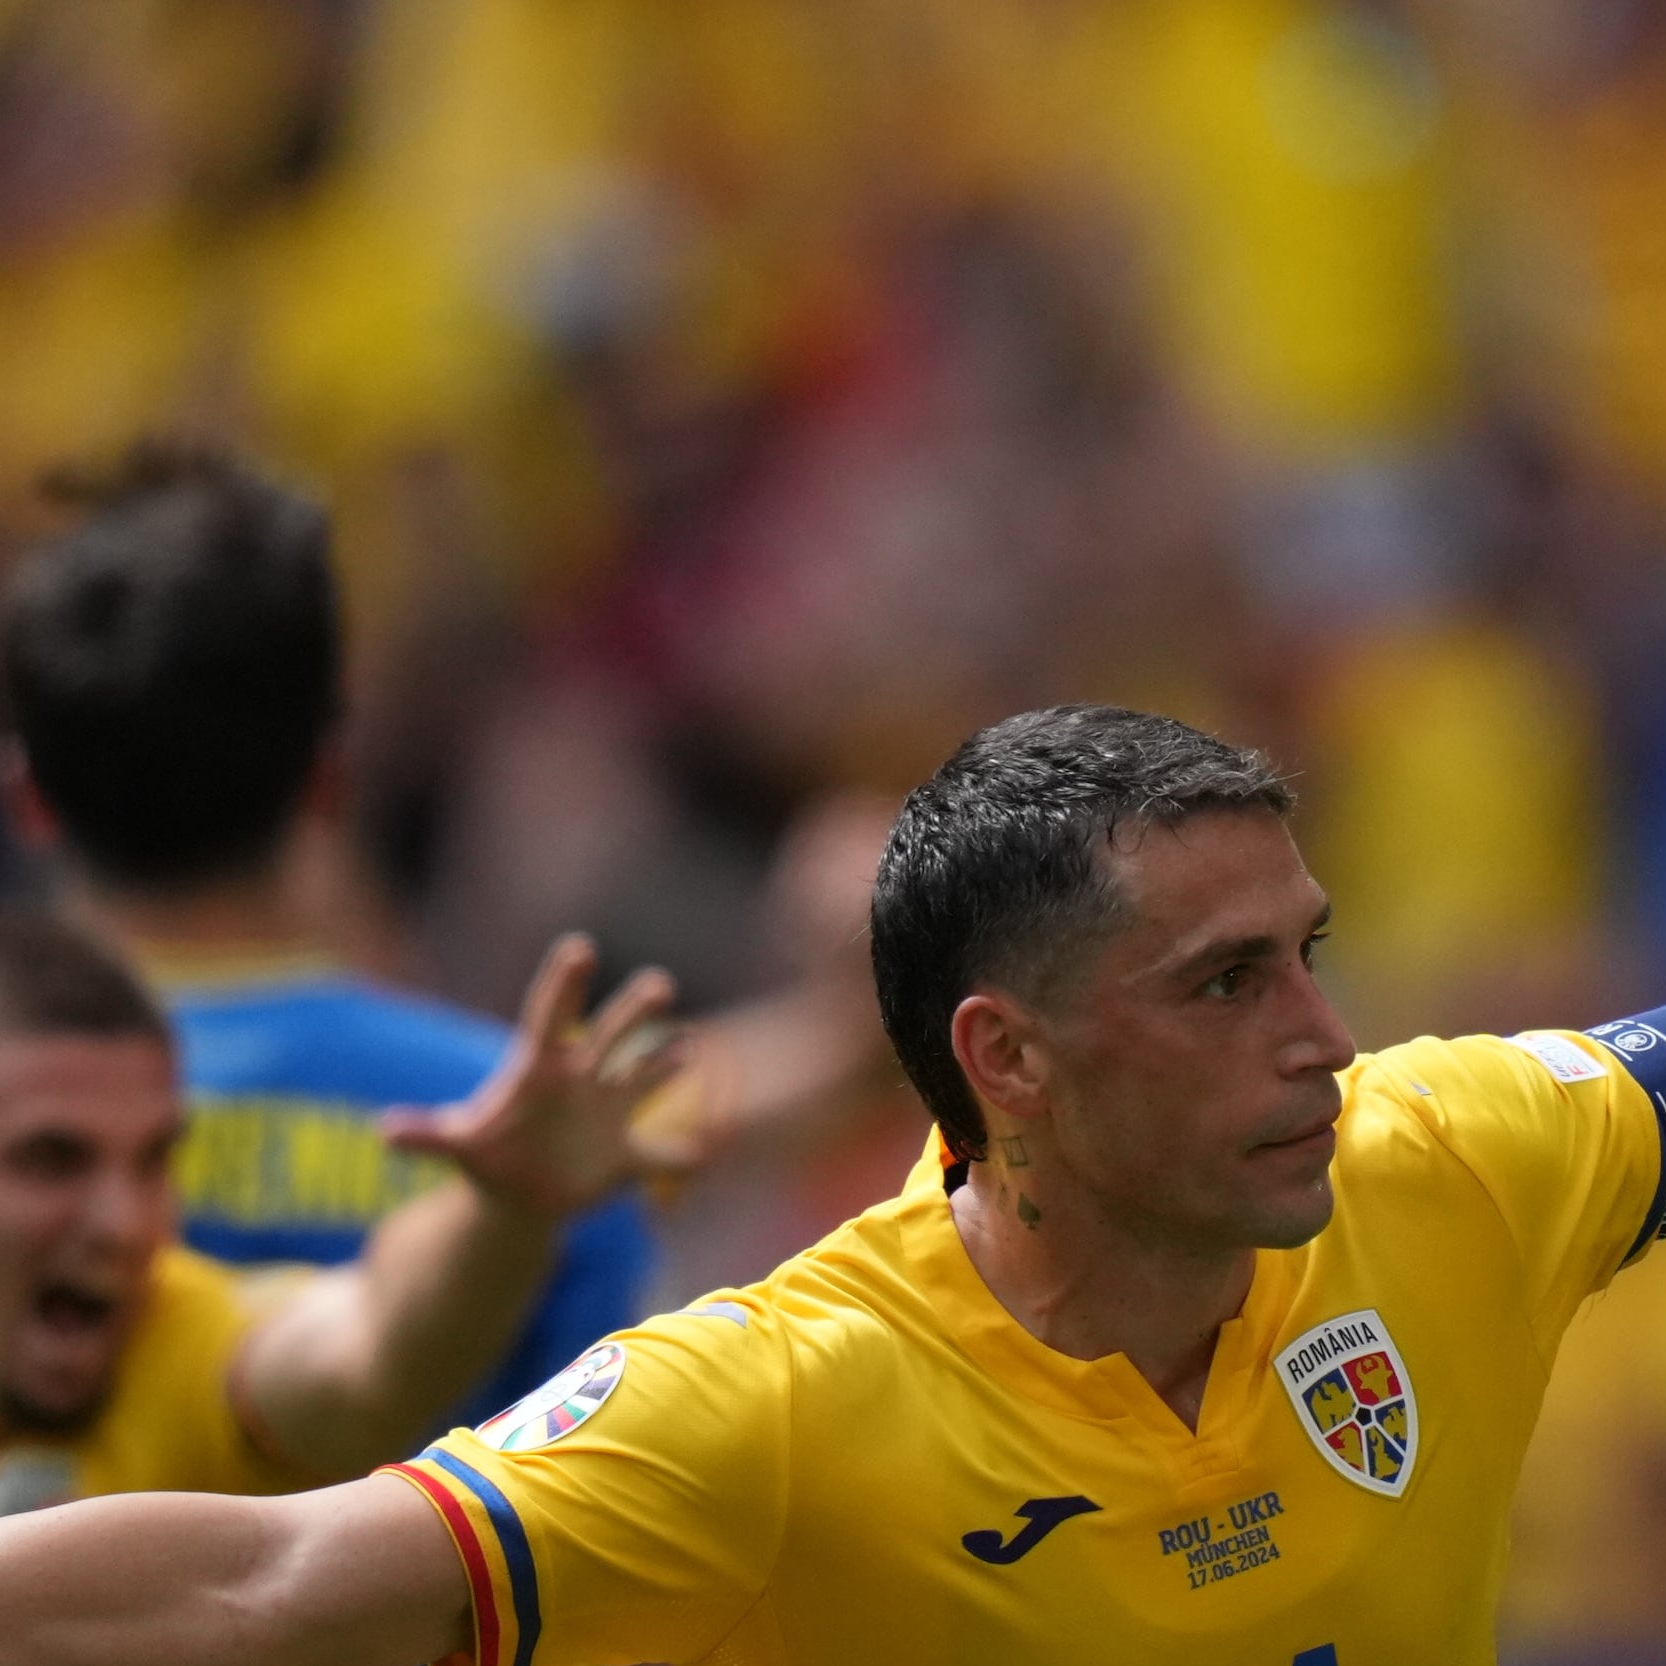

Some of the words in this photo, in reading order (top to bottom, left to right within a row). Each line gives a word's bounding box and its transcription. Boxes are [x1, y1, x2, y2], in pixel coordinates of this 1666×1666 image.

[1286, 1321, 1379, 1384] ROMÂNIA
[1158, 1516, 1212, 1555] ROU
[1228, 1490, 1284, 1530] UKR
[1187, 1525, 1271, 1569] MÜNCHEN
[1188, 1544, 1281, 1590] 17.06.2024
